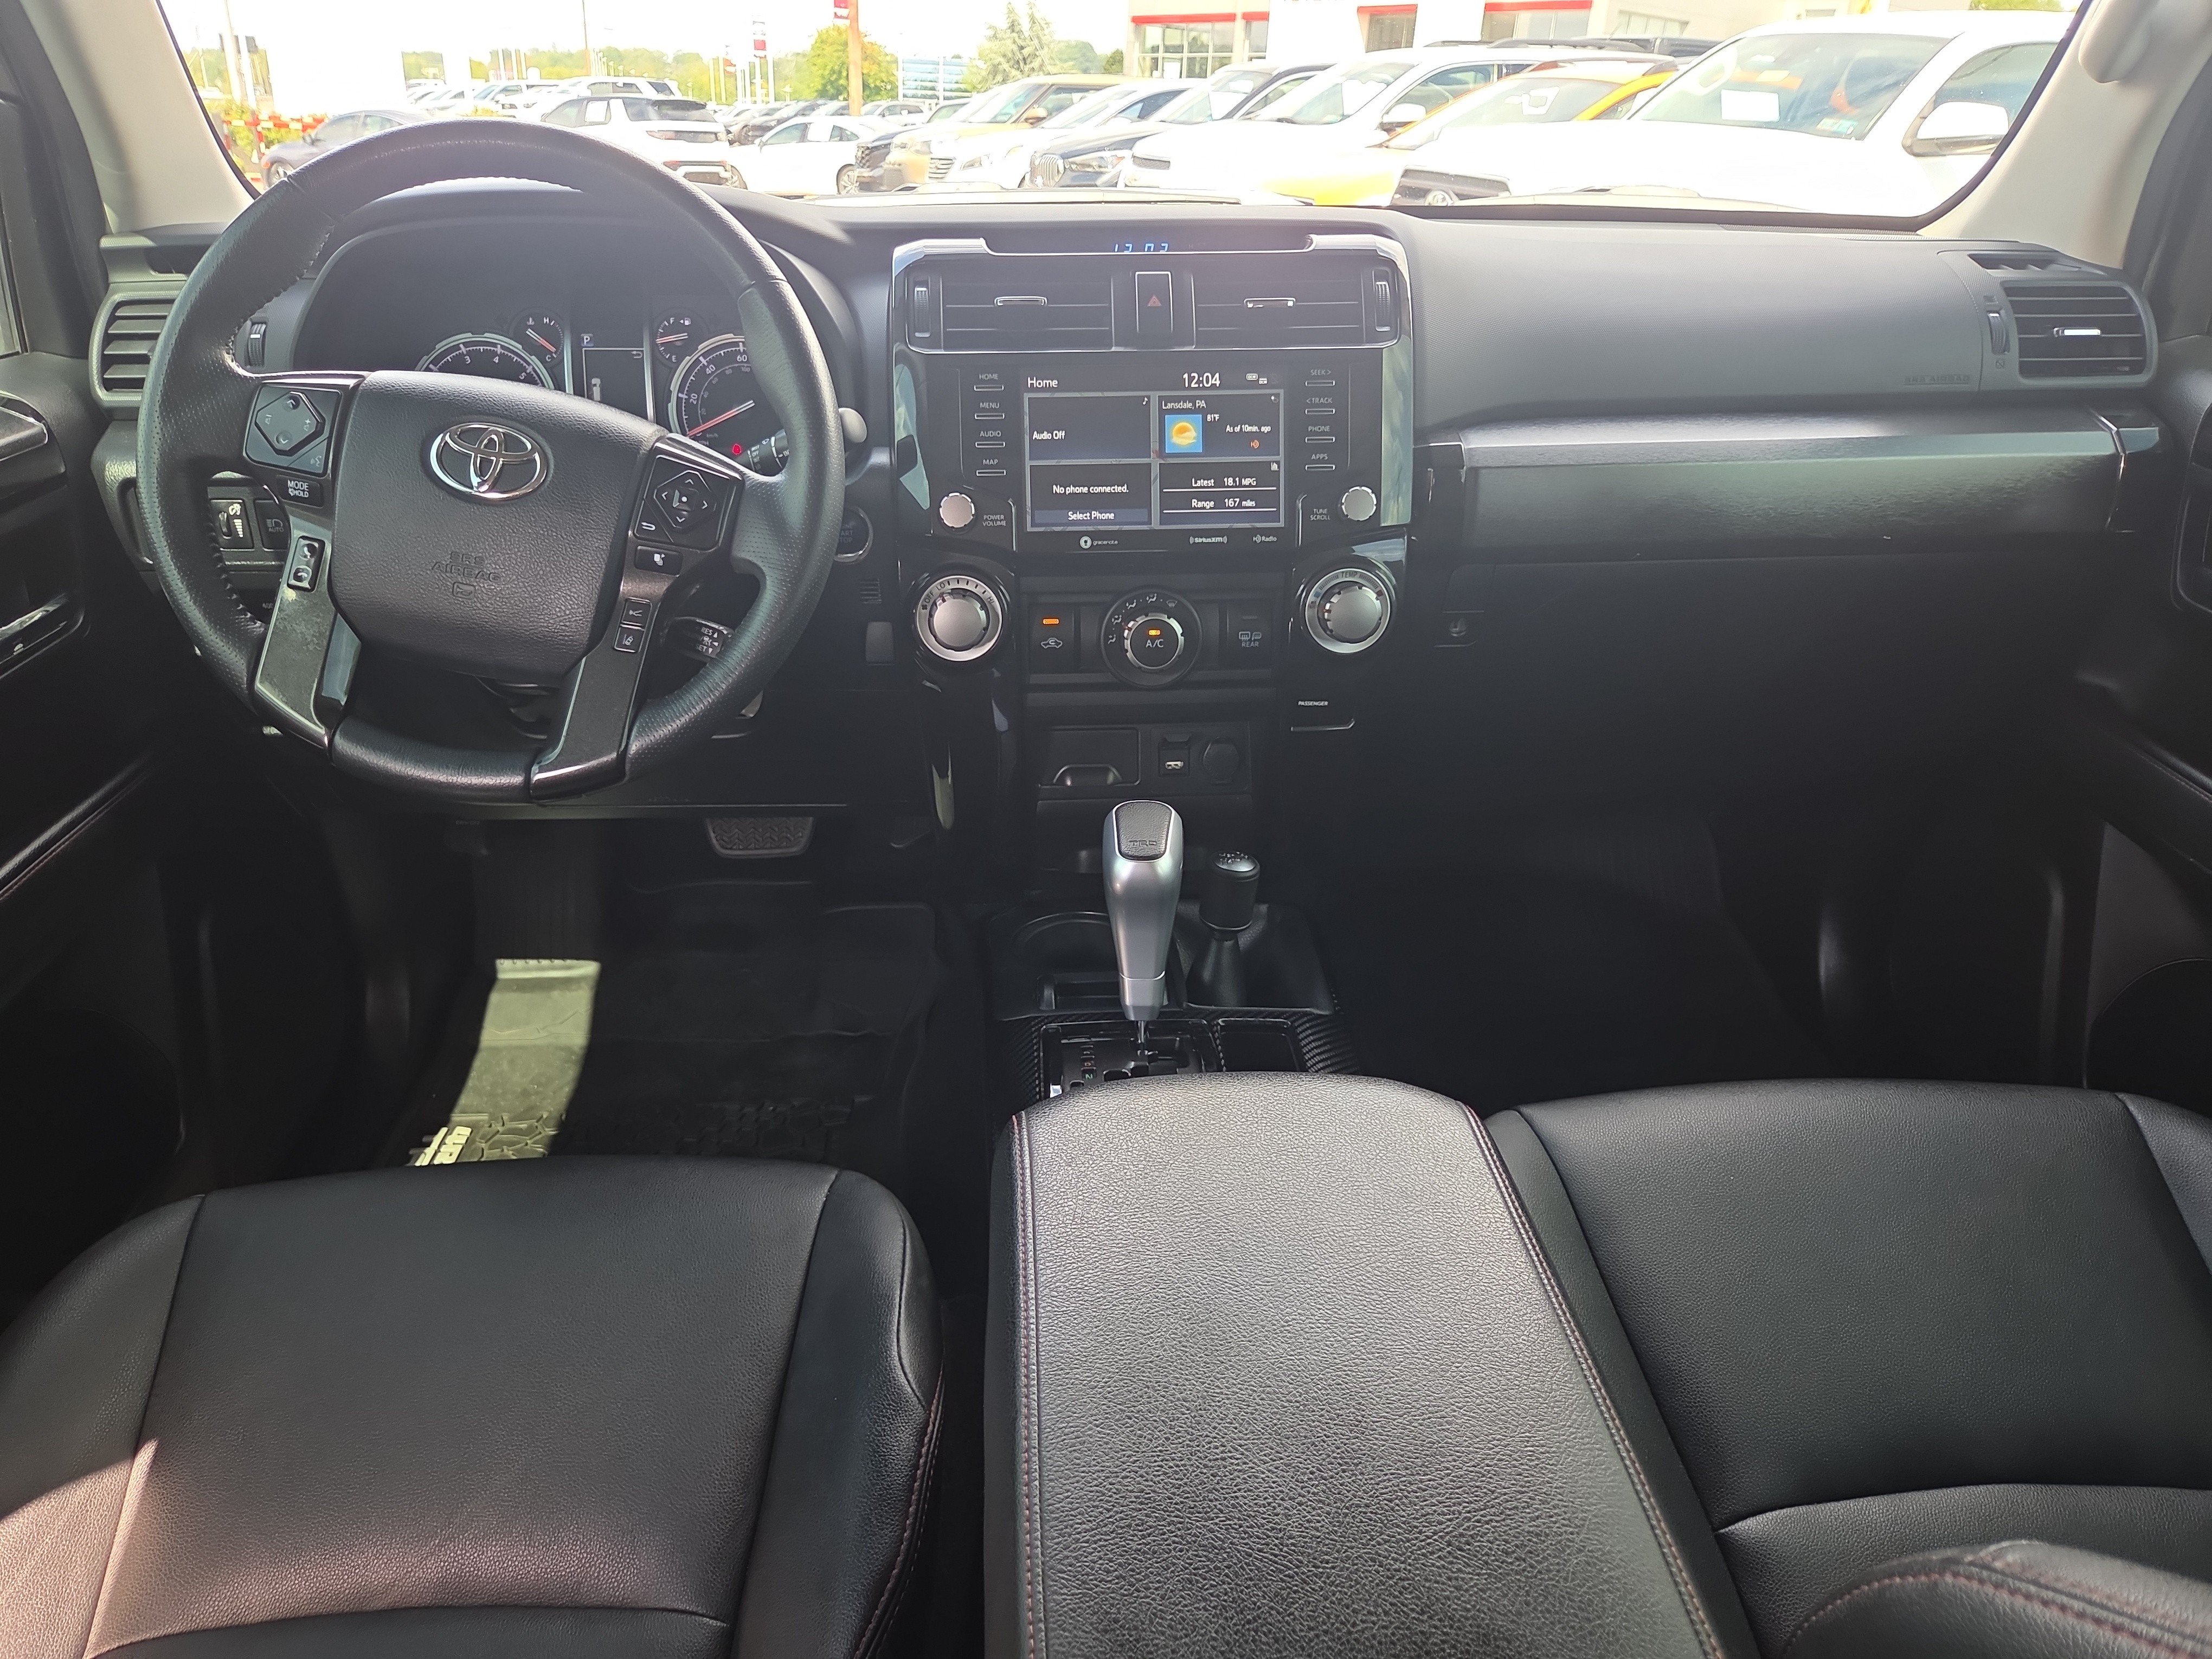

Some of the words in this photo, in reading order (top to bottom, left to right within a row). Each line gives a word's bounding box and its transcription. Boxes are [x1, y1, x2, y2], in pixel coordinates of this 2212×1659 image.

[583, 335, 591, 345] P
[464, 355, 472, 365] 3
[493, 355, 500, 364] 4
[736, 354, 748, 362] 60
[705, 364, 716, 375] 40
[518, 372, 527, 380] 5
[1182, 372, 1220, 388] 12:04
[1027, 377, 1058, 388] Home
[690, 393, 698, 405] 20
[1162, 400, 1194, 410] Lansdale,
[1195, 400, 1206, 408] PA
[1226, 425, 1233, 433] As
[1234, 425, 1241, 433] of
[1033, 431, 1052, 440] Audio
[1053, 430, 1065, 440] Off
[287, 480, 309, 491] MODE
[1192, 478, 1214, 487] Latest
[1224, 477, 1240, 486] 18.1
[1242, 478, 1257, 486] MPG
[1053, 484, 1065, 494] No
[1066, 484, 1088, 496] phone
[1090, 483, 1129, 493] connected.
[1192, 499, 1215, 509] Range
[1224, 498, 1240, 507] 167
[1068, 511, 1090, 520] Select
[1091, 511, 1115, 520] Phone
[936, 582, 946, 591] LO
[1145, 639, 1164, 648] A/C
